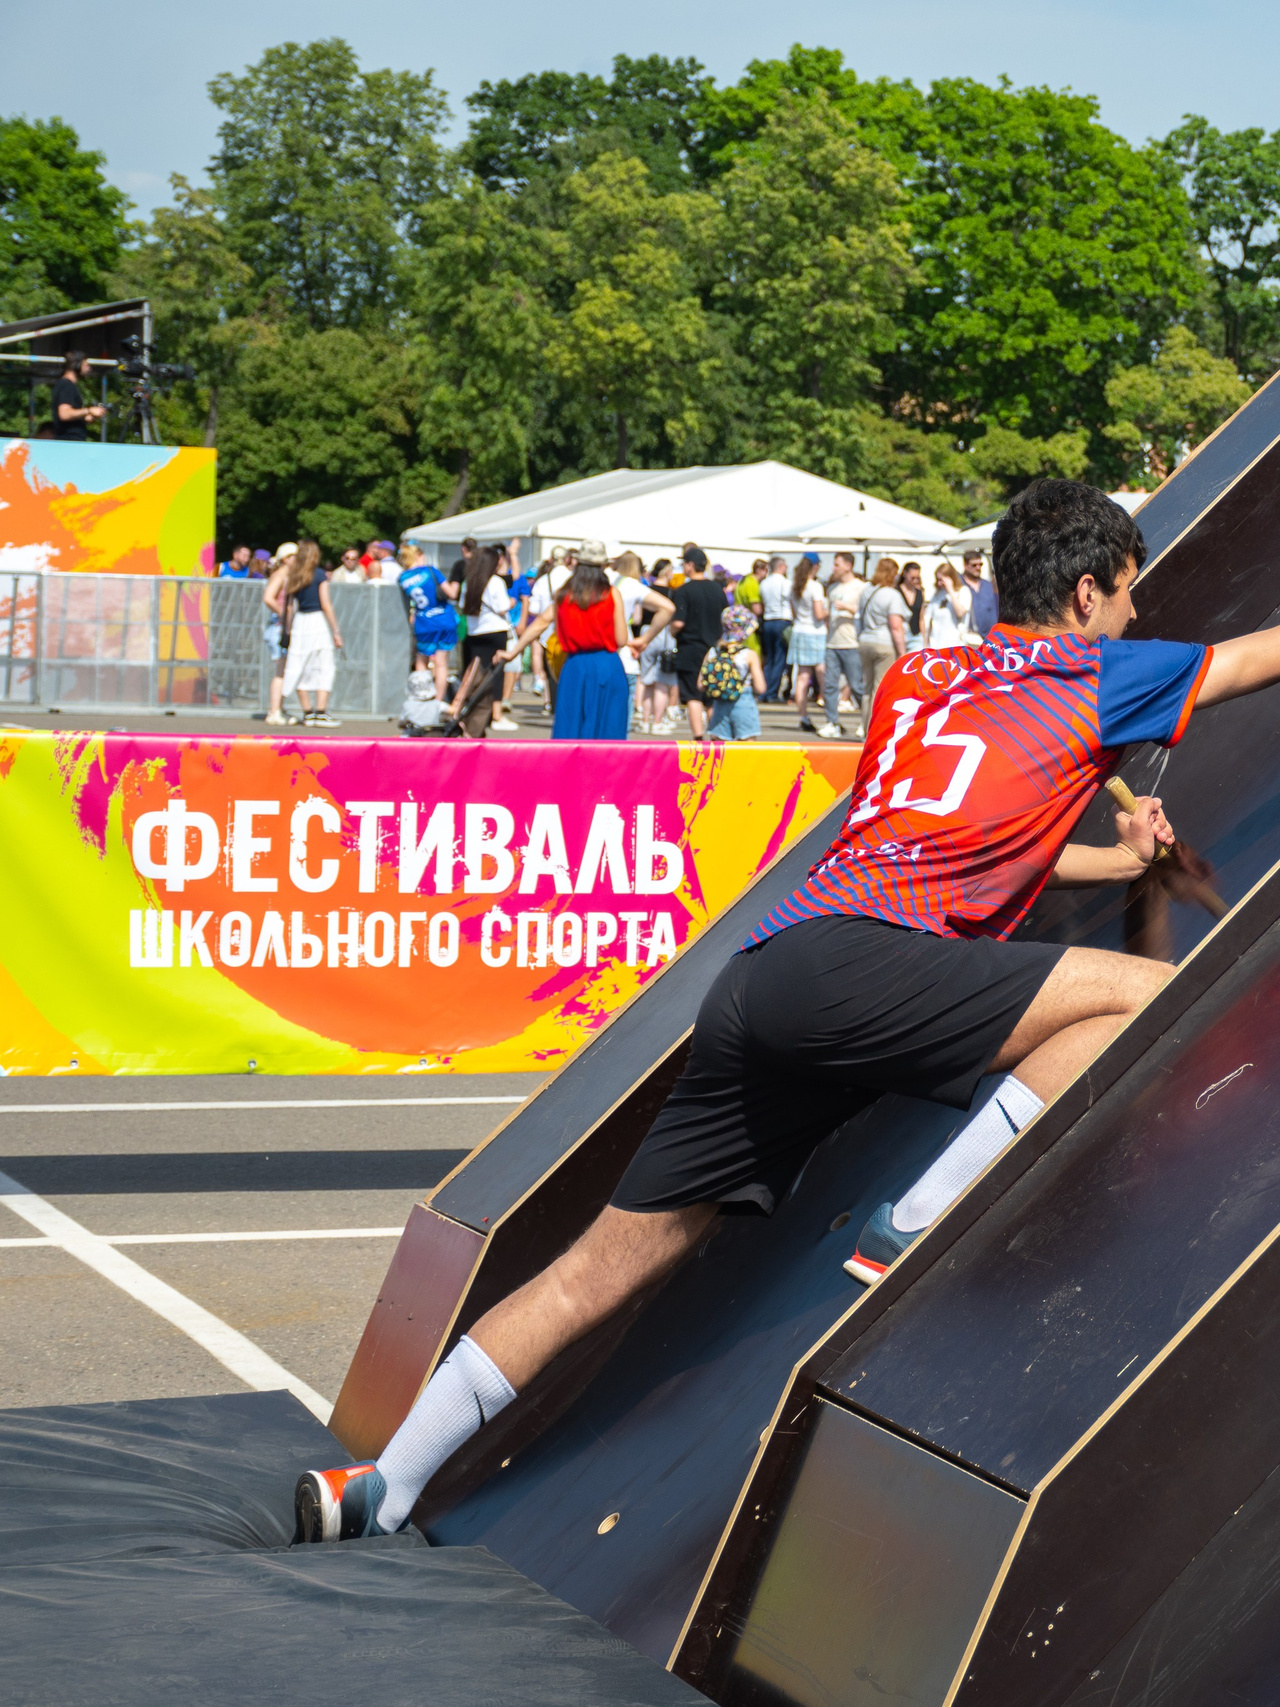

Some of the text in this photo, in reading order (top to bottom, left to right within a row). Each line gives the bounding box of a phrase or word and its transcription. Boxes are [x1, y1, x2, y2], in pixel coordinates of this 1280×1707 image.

[849, 684, 1014, 827] 15
[132, 796, 685, 895] ФЕСТИВАЛЬ
[129, 907, 678, 969] ШКОЛЬНОГО СПОРТА
